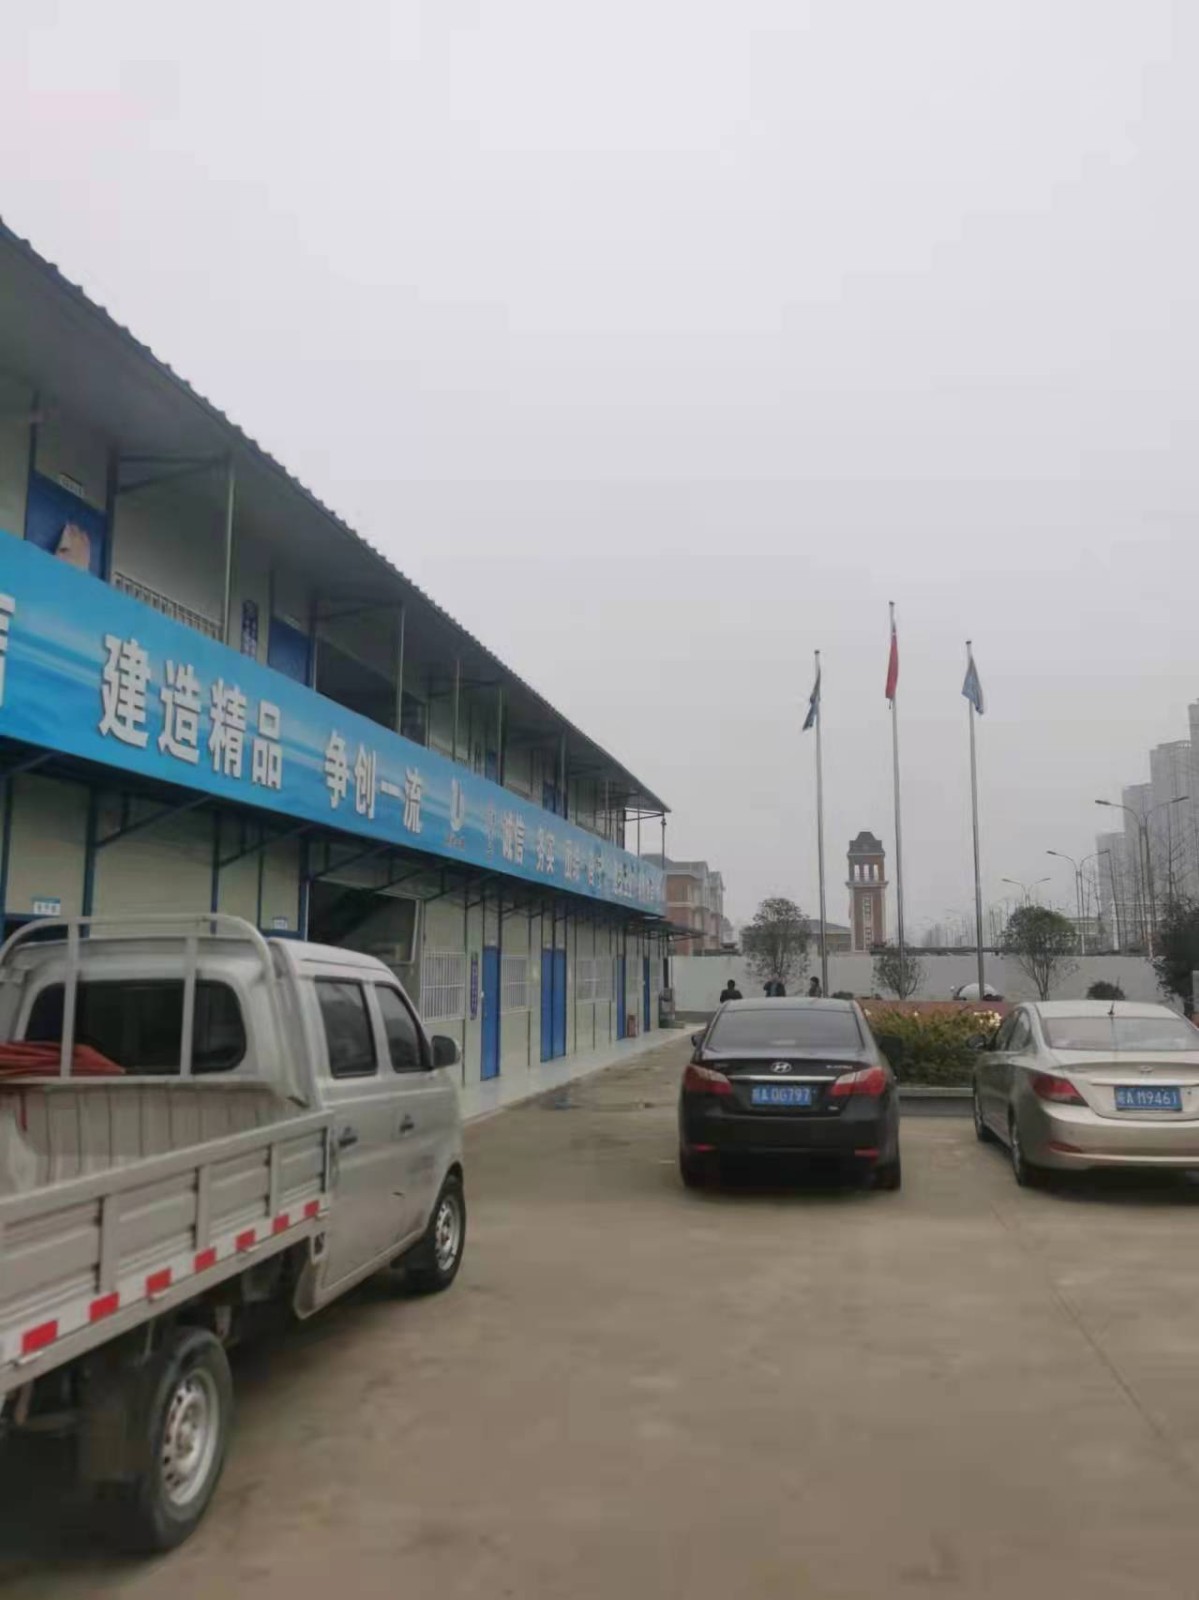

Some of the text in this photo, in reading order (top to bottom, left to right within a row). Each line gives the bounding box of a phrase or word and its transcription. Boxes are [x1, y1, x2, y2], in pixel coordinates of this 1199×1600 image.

[98, 633, 283, 790] 建造精品
[324, 730, 424, 834] 争创一流
